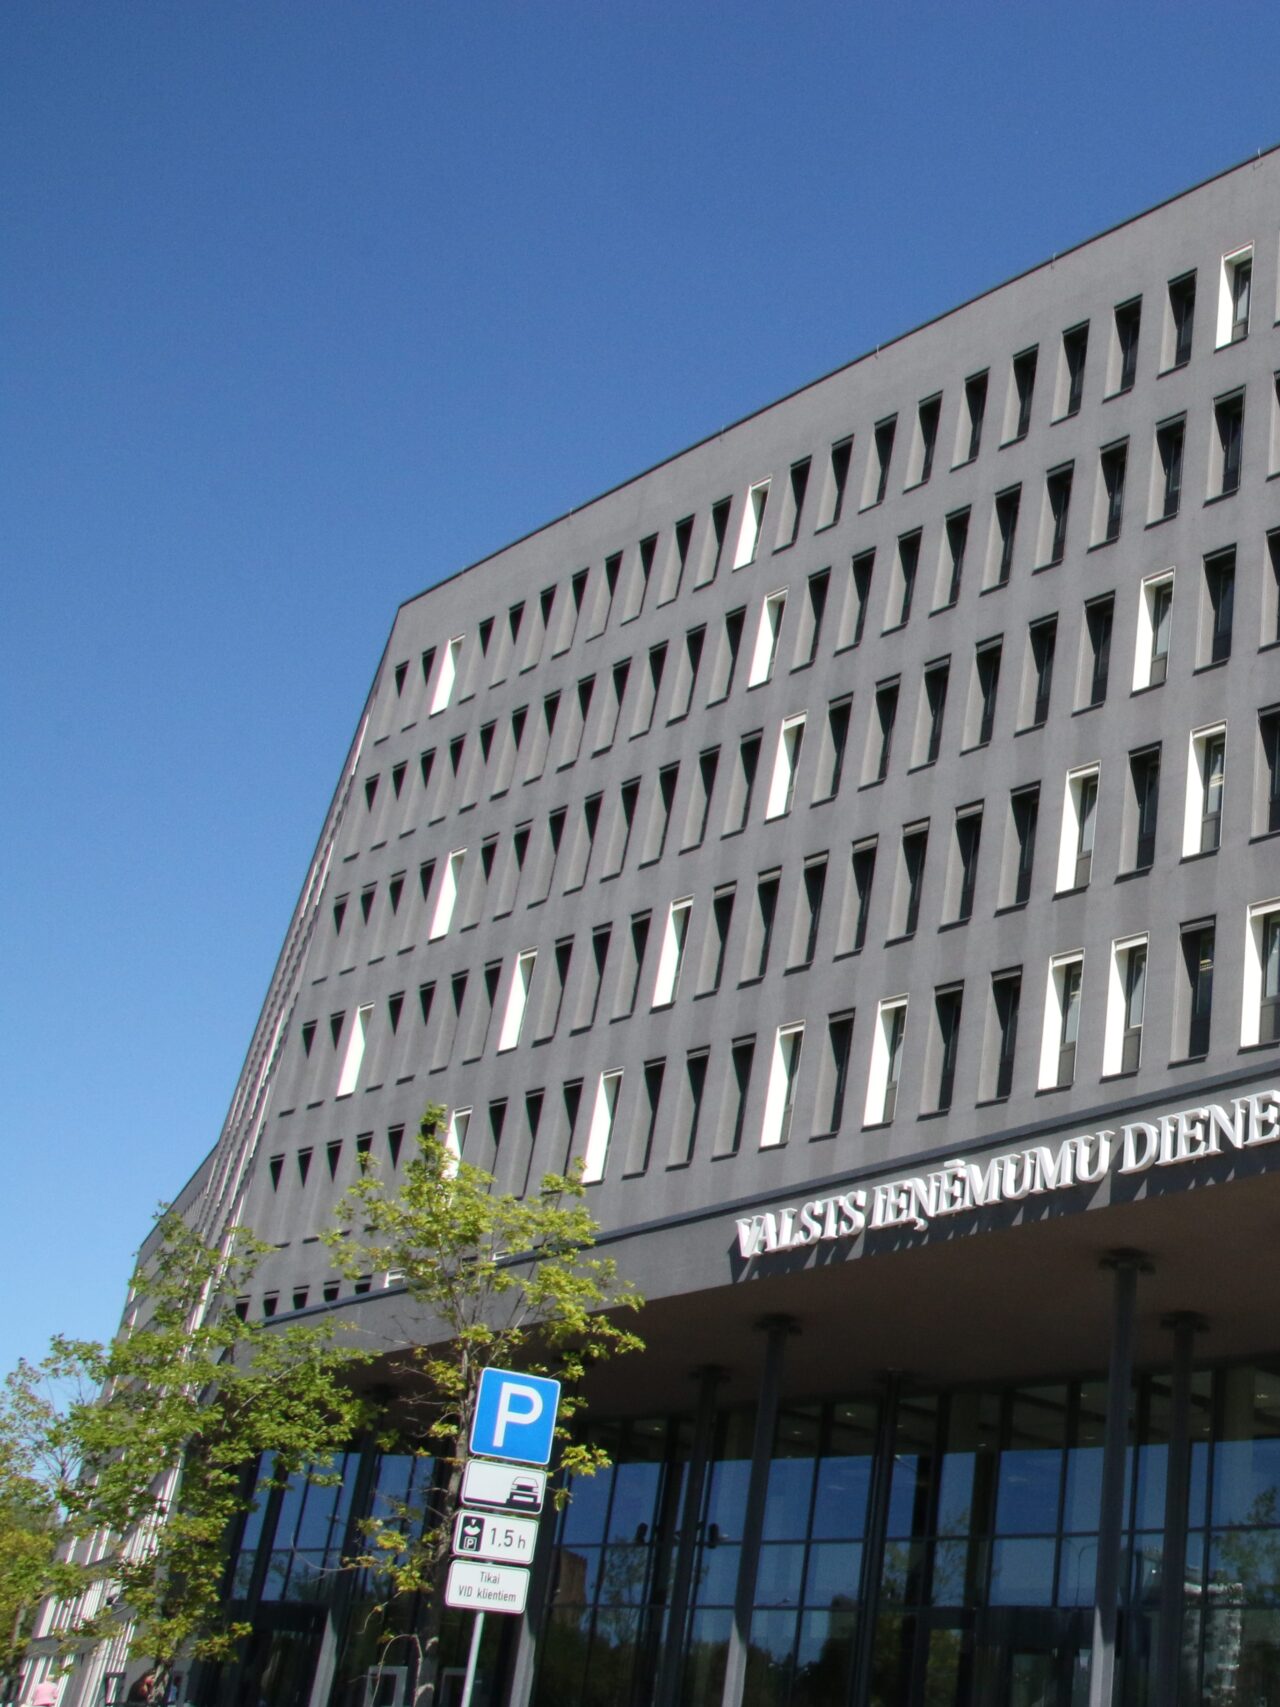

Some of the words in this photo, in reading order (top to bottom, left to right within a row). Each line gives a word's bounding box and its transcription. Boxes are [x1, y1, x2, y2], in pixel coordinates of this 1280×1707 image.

[736, 1190, 867, 1259] VALSTS
[869, 1130, 1115, 1232] IEŅĒMUMU
[493, 1382, 543, 1447] P
[517, 1534, 526, 1549] h
[480, 1571, 500, 1584] Tikai
[458, 1585, 473, 1598] VID
[476, 1587, 517, 1602] klientiem
